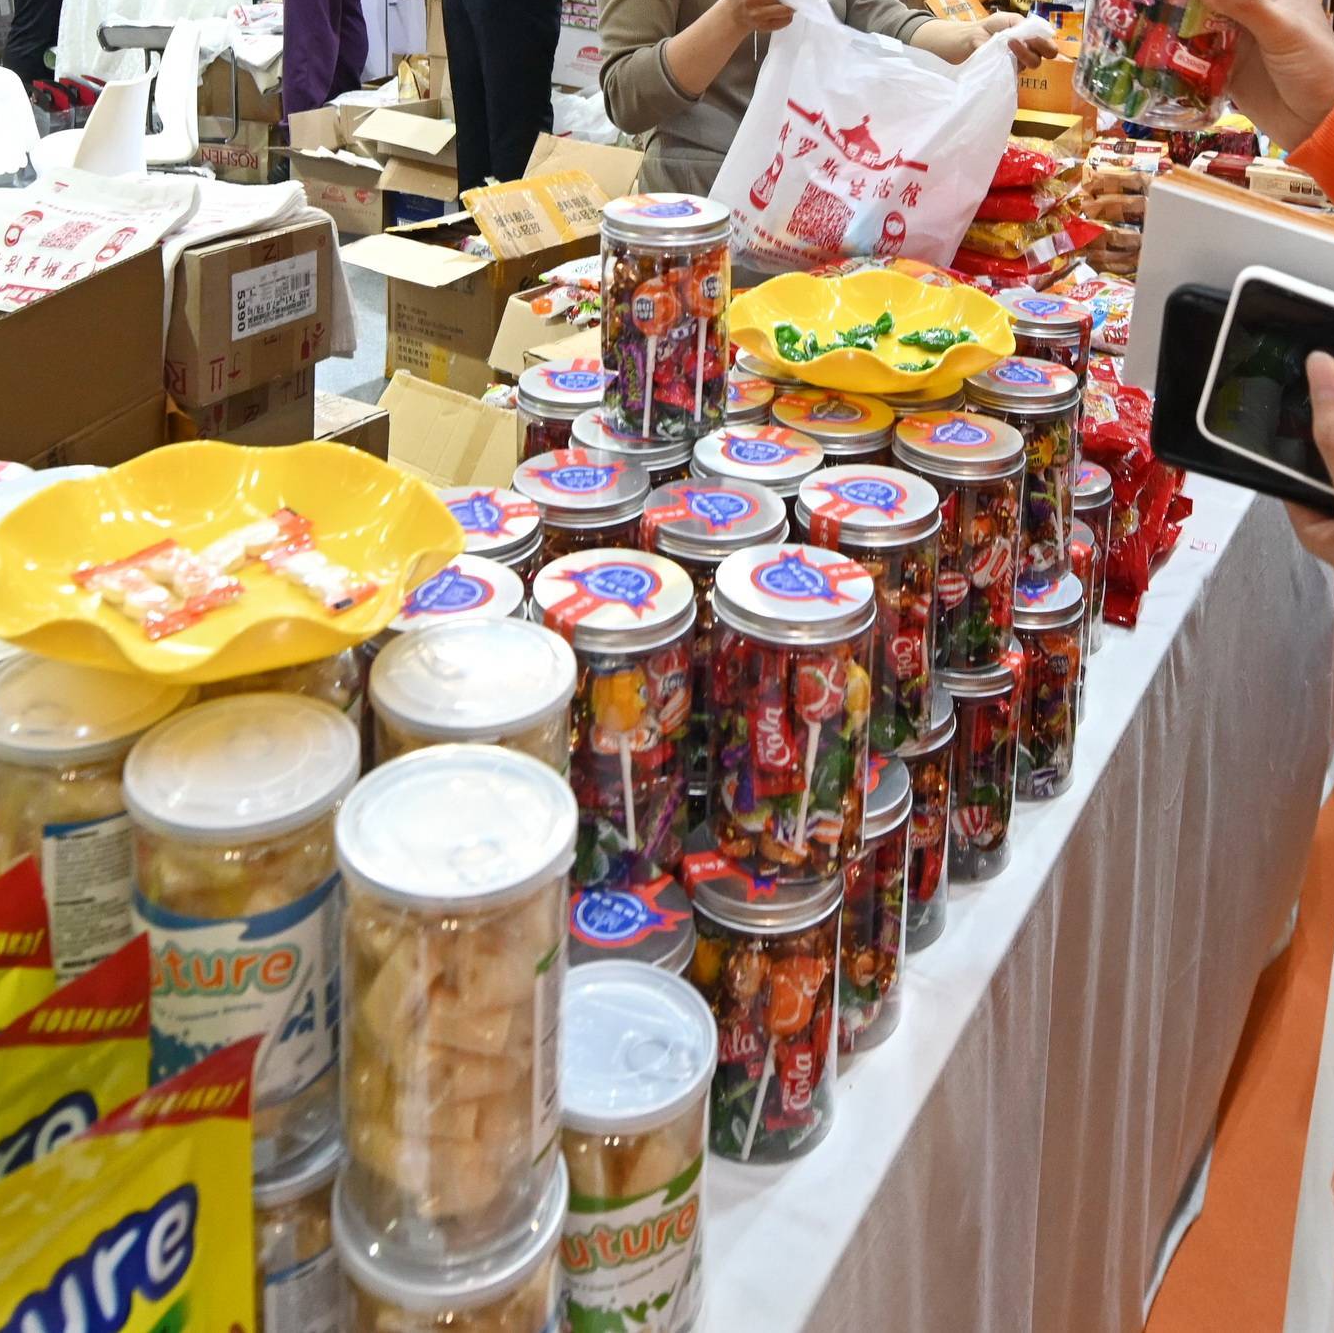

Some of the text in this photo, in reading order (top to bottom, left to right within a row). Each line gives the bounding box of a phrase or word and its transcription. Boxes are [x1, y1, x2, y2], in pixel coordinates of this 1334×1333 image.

[236, 290, 247, 333] 5390
[756, 707, 791, 767] Cola
[560, 1195, 701, 1269] uture
